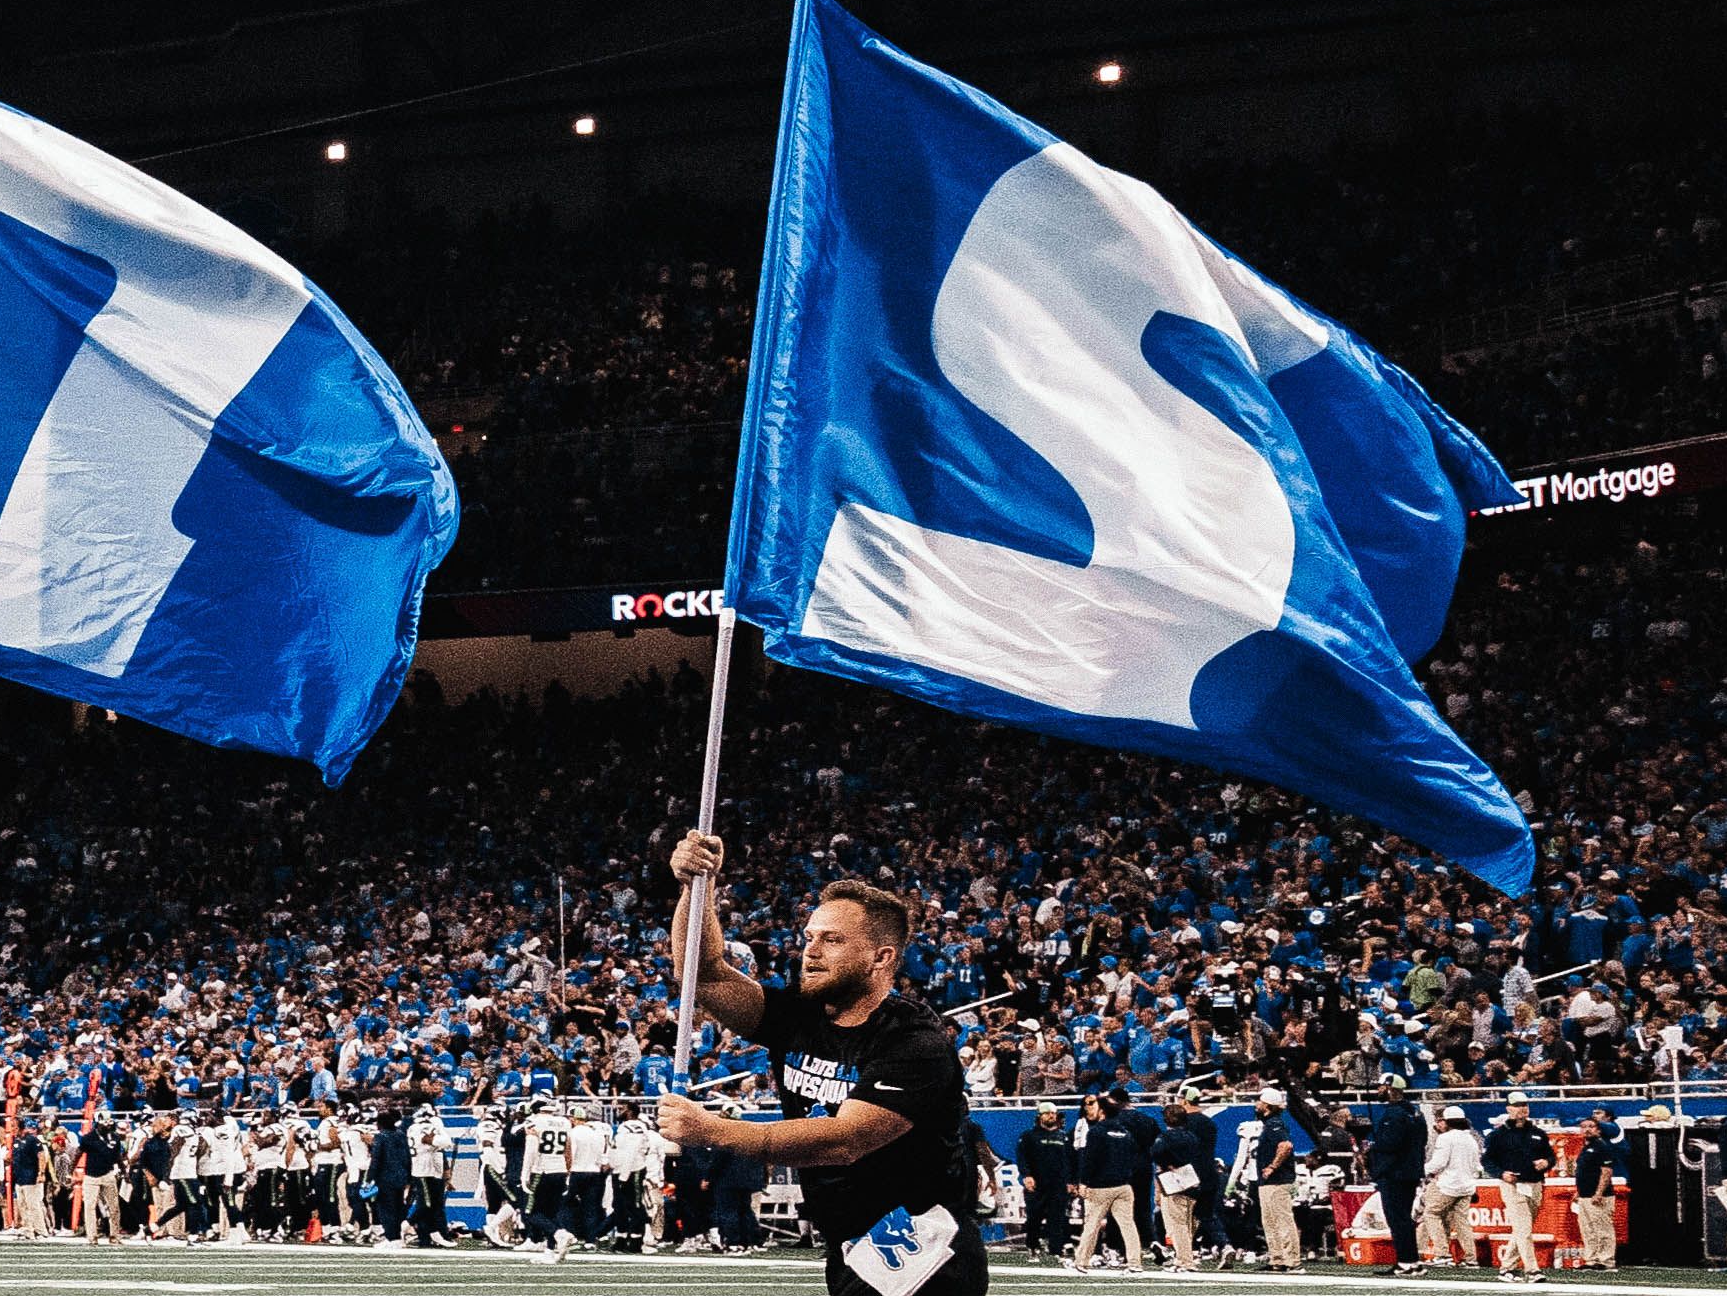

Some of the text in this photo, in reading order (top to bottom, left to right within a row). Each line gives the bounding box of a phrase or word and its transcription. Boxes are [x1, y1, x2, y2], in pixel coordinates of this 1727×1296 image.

[801, 141, 1327, 729] S
[1550, 462, 1676, 505] Mortgage
[611, 589, 725, 620] ROCKE
[539, 1130, 568, 1155] 89
